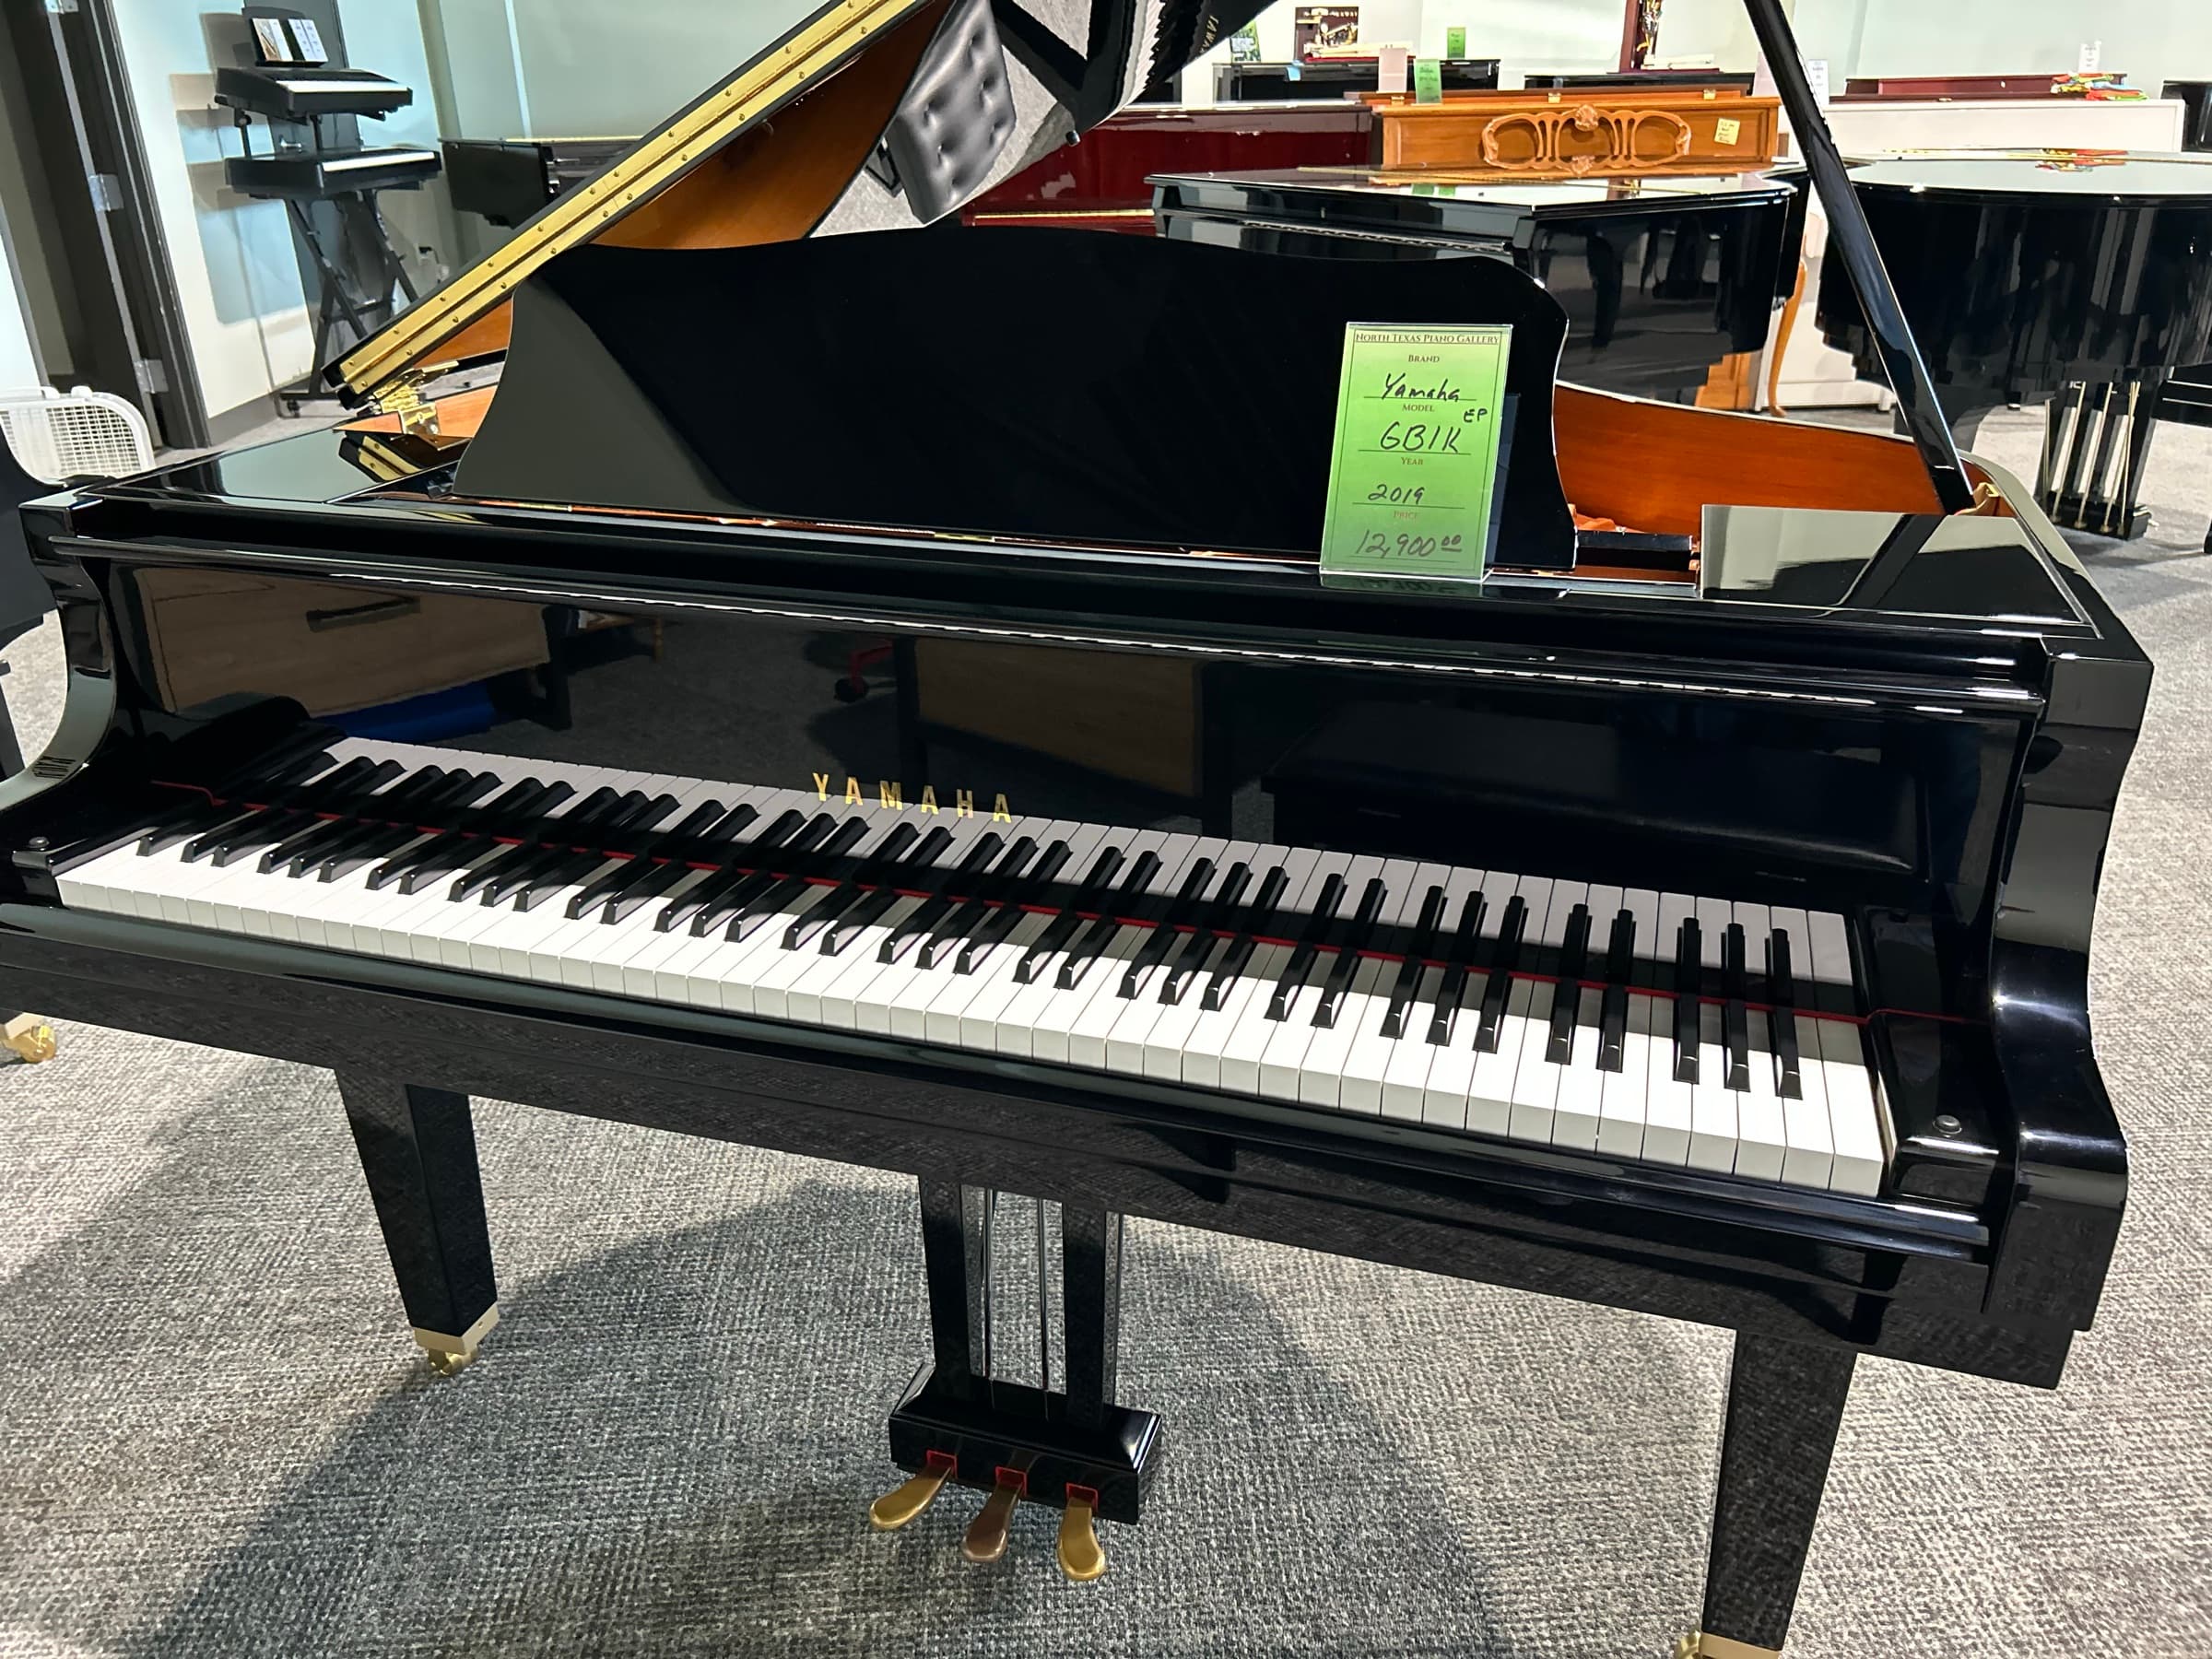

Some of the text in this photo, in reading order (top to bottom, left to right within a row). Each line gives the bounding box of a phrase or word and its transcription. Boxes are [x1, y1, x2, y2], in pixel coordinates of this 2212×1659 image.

[1356, 333, 1500, 344] NORTH TEXAS PIANO GALLERY
[1407, 354, 1441, 363] BRAND
[1381, 372, 1461, 403] Yamaha
[1401, 404, 1435, 413] MODEL
[1463, 407, 1488, 423] EP
[1400, 456, 1424, 466] YEAR
[1367, 483, 1426, 505] 2019
[812, 771, 1012, 824] YAMAHA
